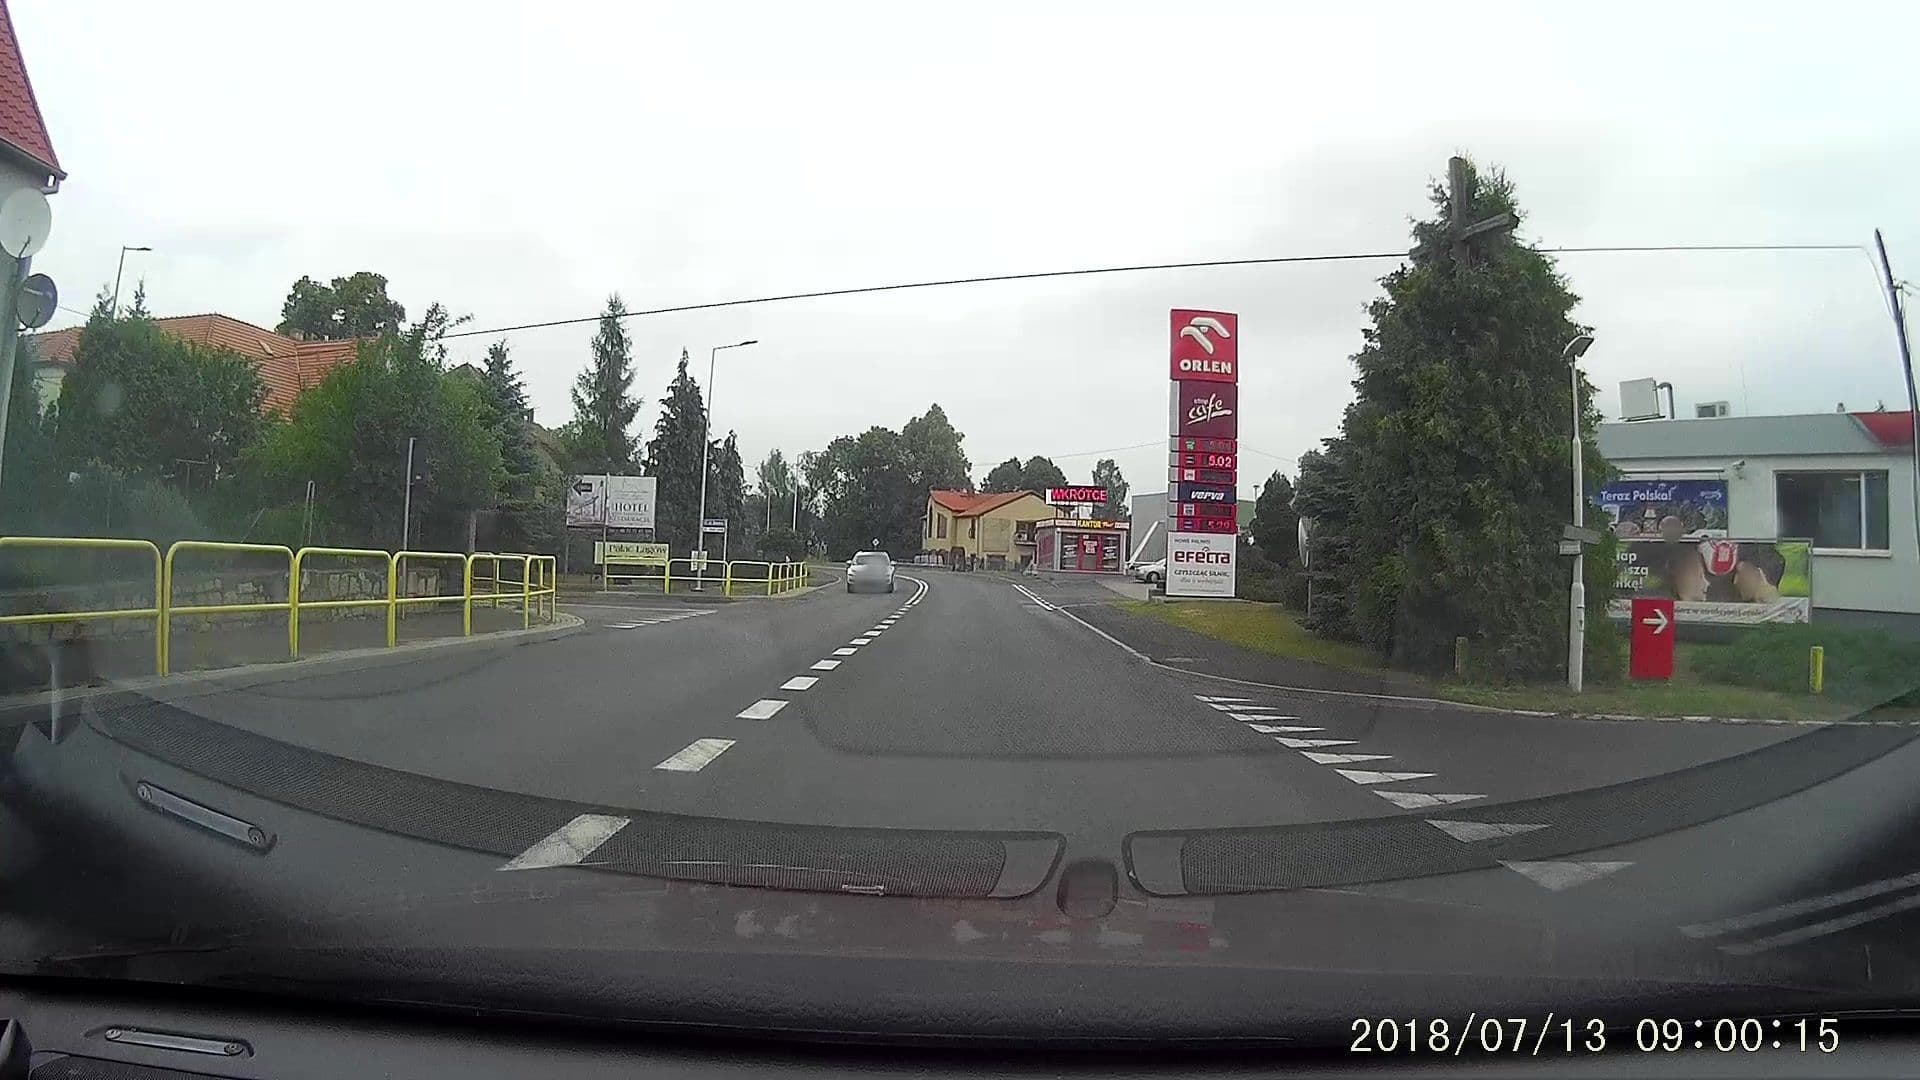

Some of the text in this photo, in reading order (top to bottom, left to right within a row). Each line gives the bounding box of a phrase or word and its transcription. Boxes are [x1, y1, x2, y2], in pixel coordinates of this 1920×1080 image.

[1179, 359, 1232, 374] ORLEN
[1051, 487, 1107, 501] WKRÓTCE
[1601, 490, 1672, 501] Teraz Polska!
[615, 503, 648, 512] HOTEL
[1077, 520, 1102, 528] KANTOR
